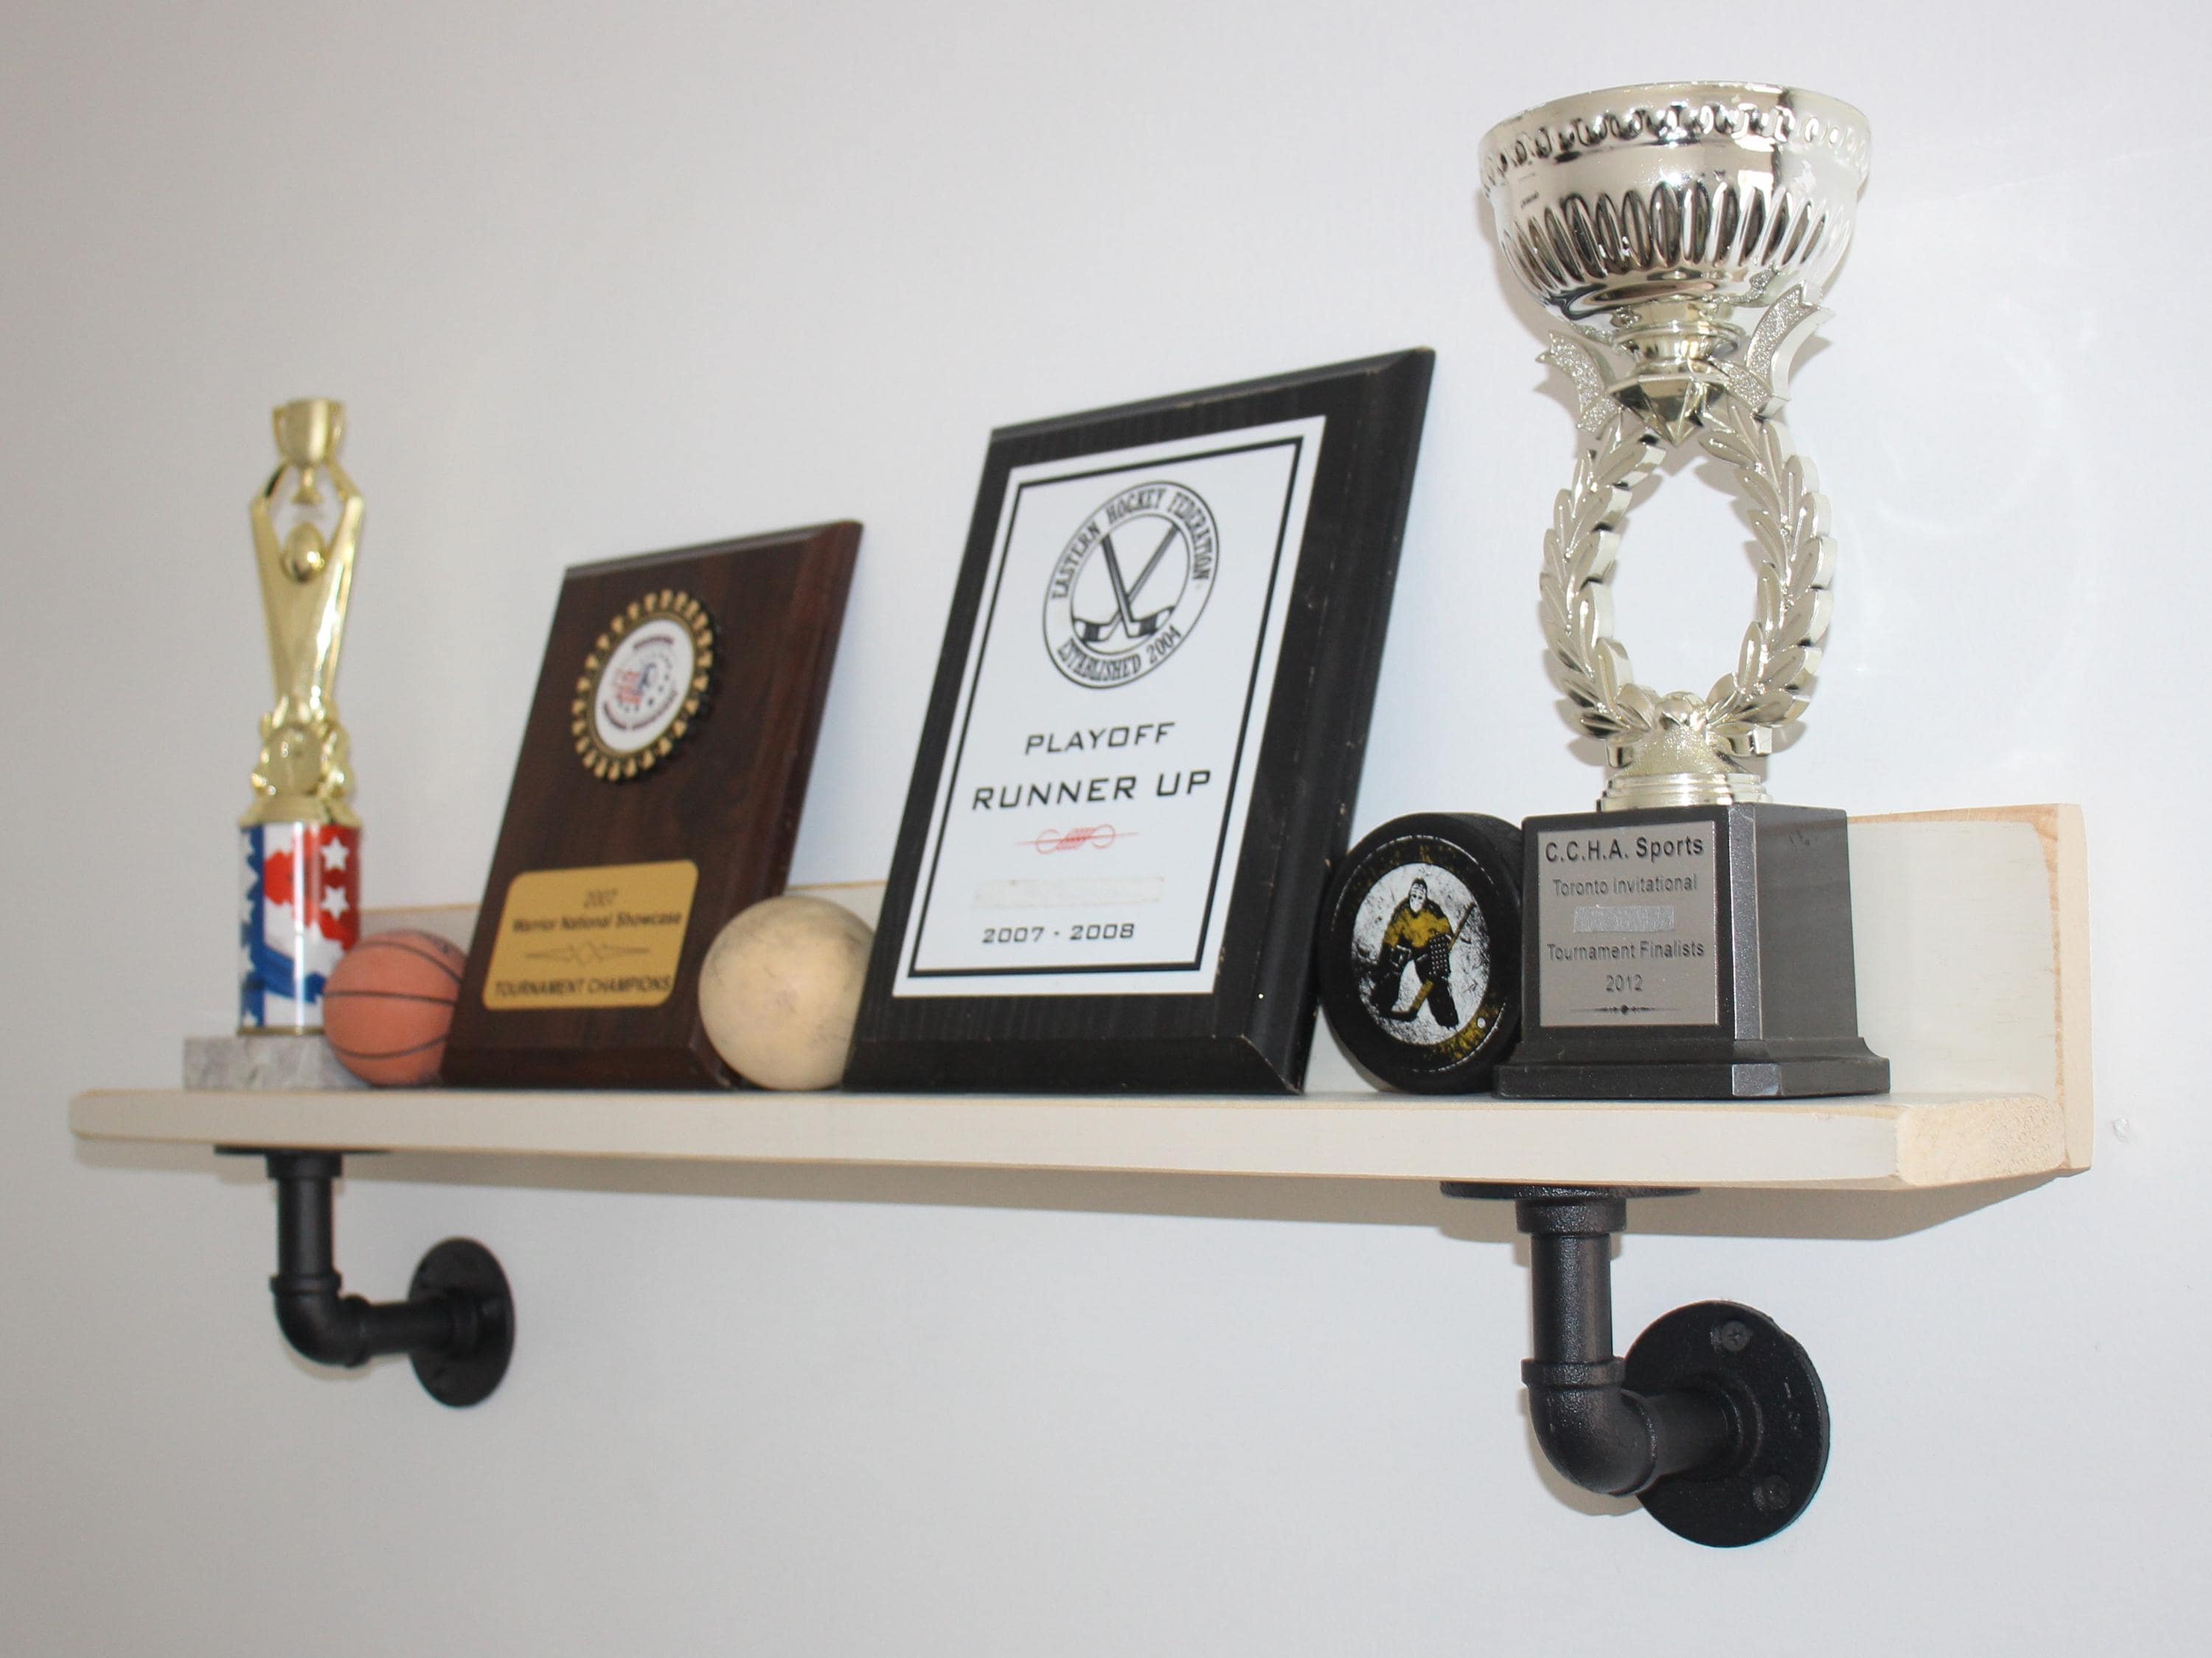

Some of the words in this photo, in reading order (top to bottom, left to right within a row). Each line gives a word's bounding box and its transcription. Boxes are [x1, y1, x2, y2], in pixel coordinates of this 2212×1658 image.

[1051, 521, 1101, 600] EASTERN
[1105, 487, 1166, 524] HOCKEY
[1167, 492, 1213, 580] FEDERATION
[1057, 638, 1142, 681] ESTABLISHED
[1145, 625, 1182, 664] 2004
[1025, 722, 1175, 756] PLAYOFF
[971, 776, 1137, 811] RUNNER
[1155, 770, 1211, 797] UP
[1545, 837, 1629, 862] C.C.H.A.
[1635, 835, 1705, 863] Sports
[1552, 878, 1609, 897] Toronto
[1613, 873, 1697, 894] Invitational
[981, 926, 1045, 944] 2007
[1069, 923, 1135, 941] 2008
[1546, 942, 1635, 961] Tournament
[1639, 940, 1705, 958] Finalists
[495, 978, 585, 997] TOURNAMENT
[588, 975, 672, 994] CHAMPIONS
[1605, 973, 1644, 992] 2012
